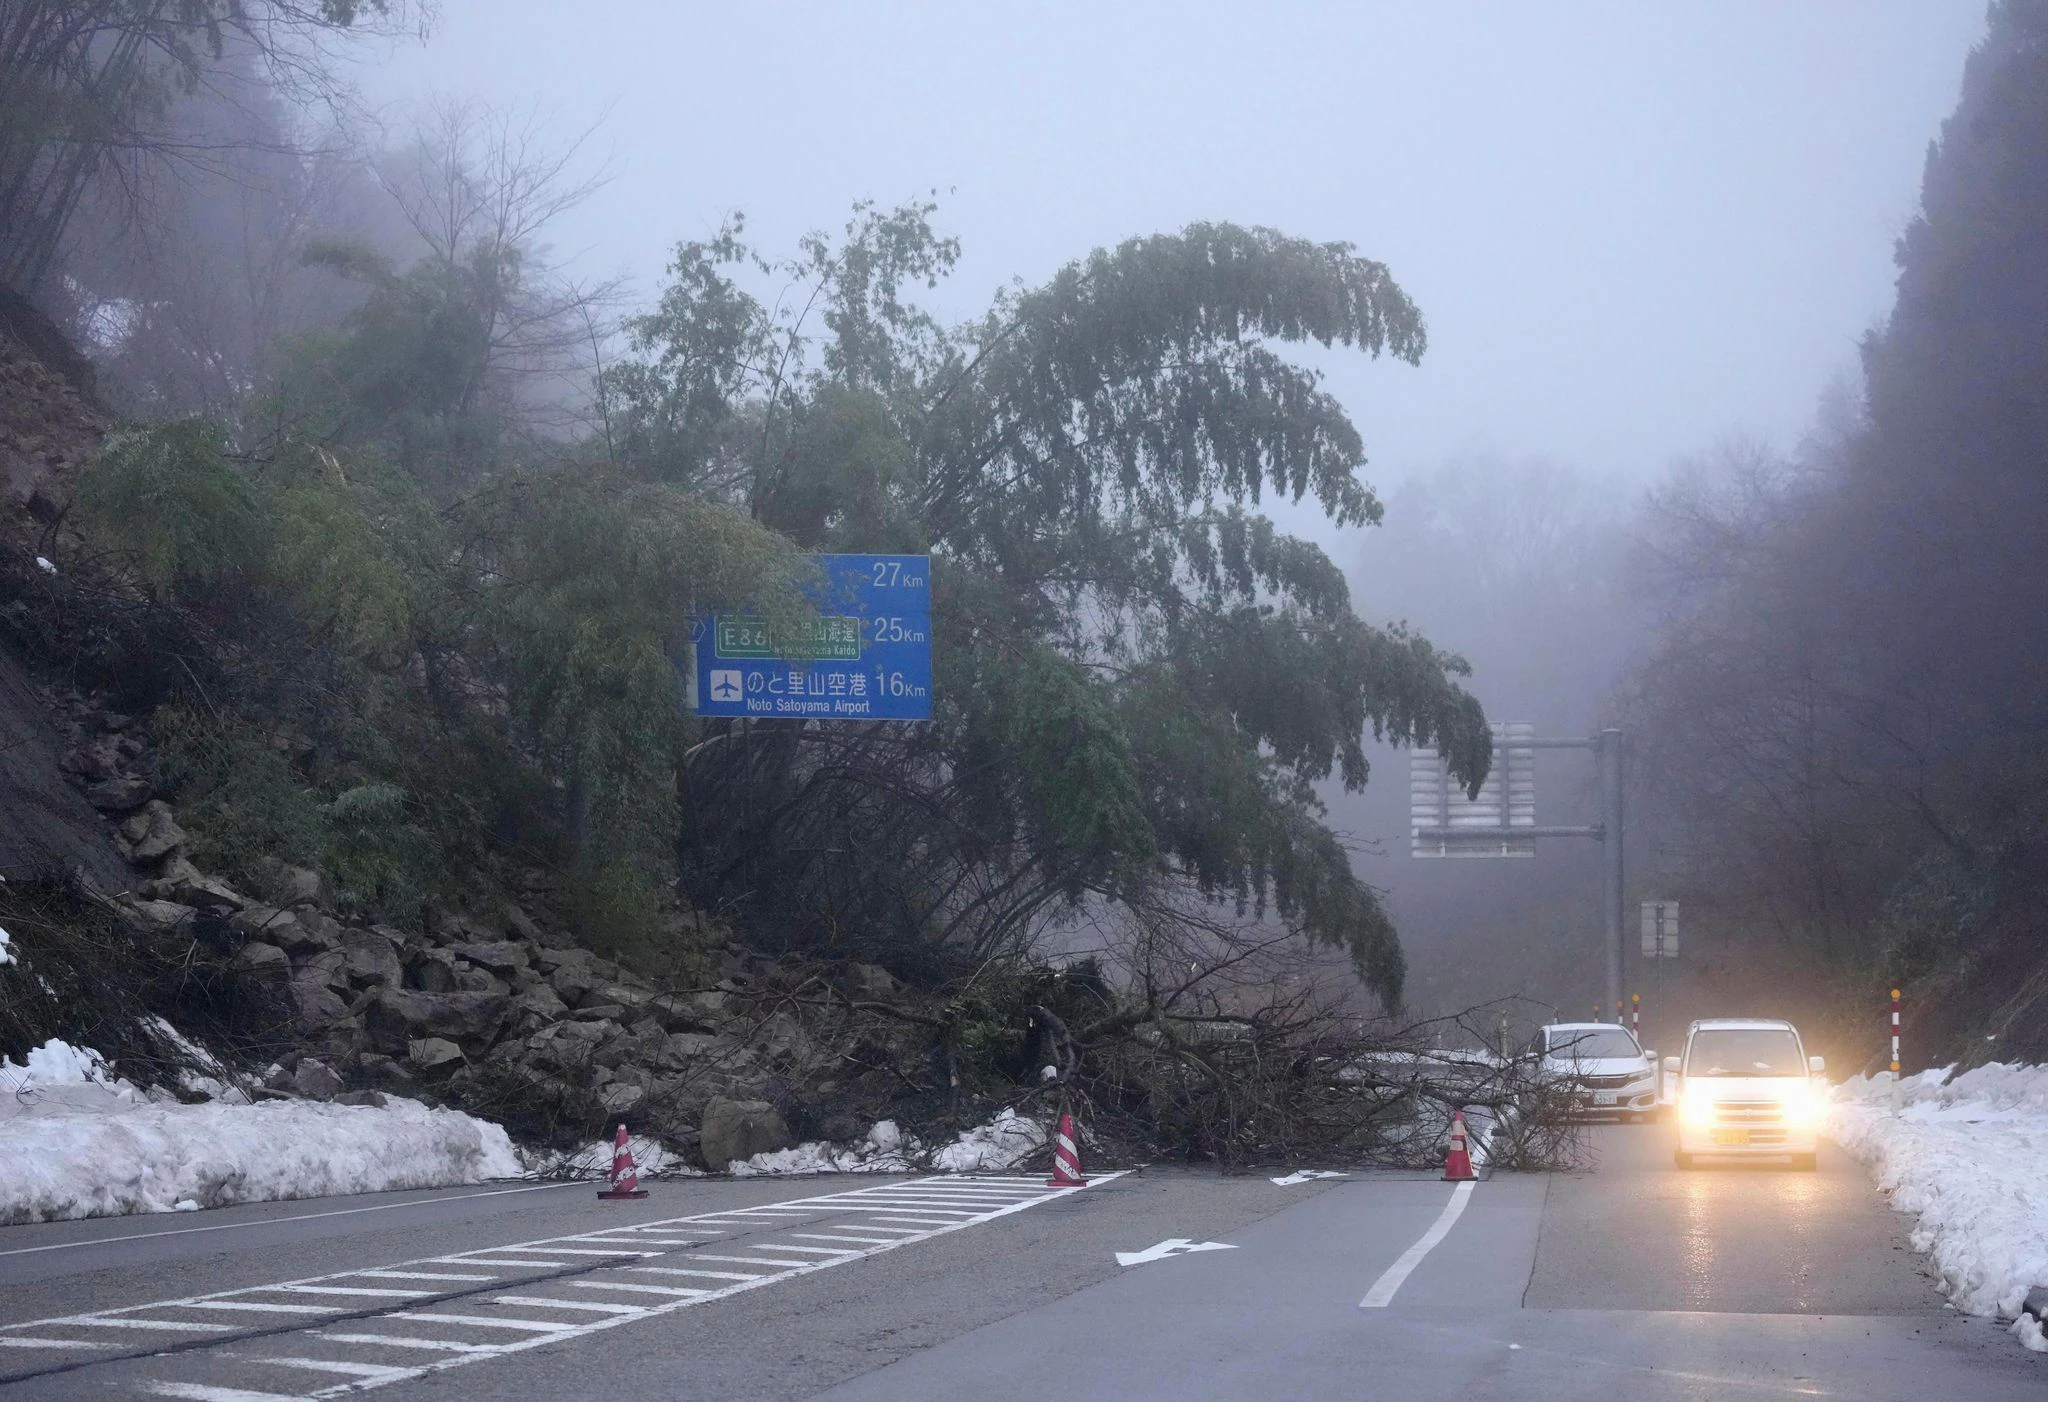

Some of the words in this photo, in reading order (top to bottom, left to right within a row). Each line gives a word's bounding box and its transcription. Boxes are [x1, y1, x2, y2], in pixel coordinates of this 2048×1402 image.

[724, 628, 767, 646] E86
[834, 643, 857, 656] Kaido
[746, 671, 867, 697] のと里山空港
[747, 698, 773, 711] Noto
[776, 699, 830, 714] Satoyama
[834, 699, 870, 715] Airport
